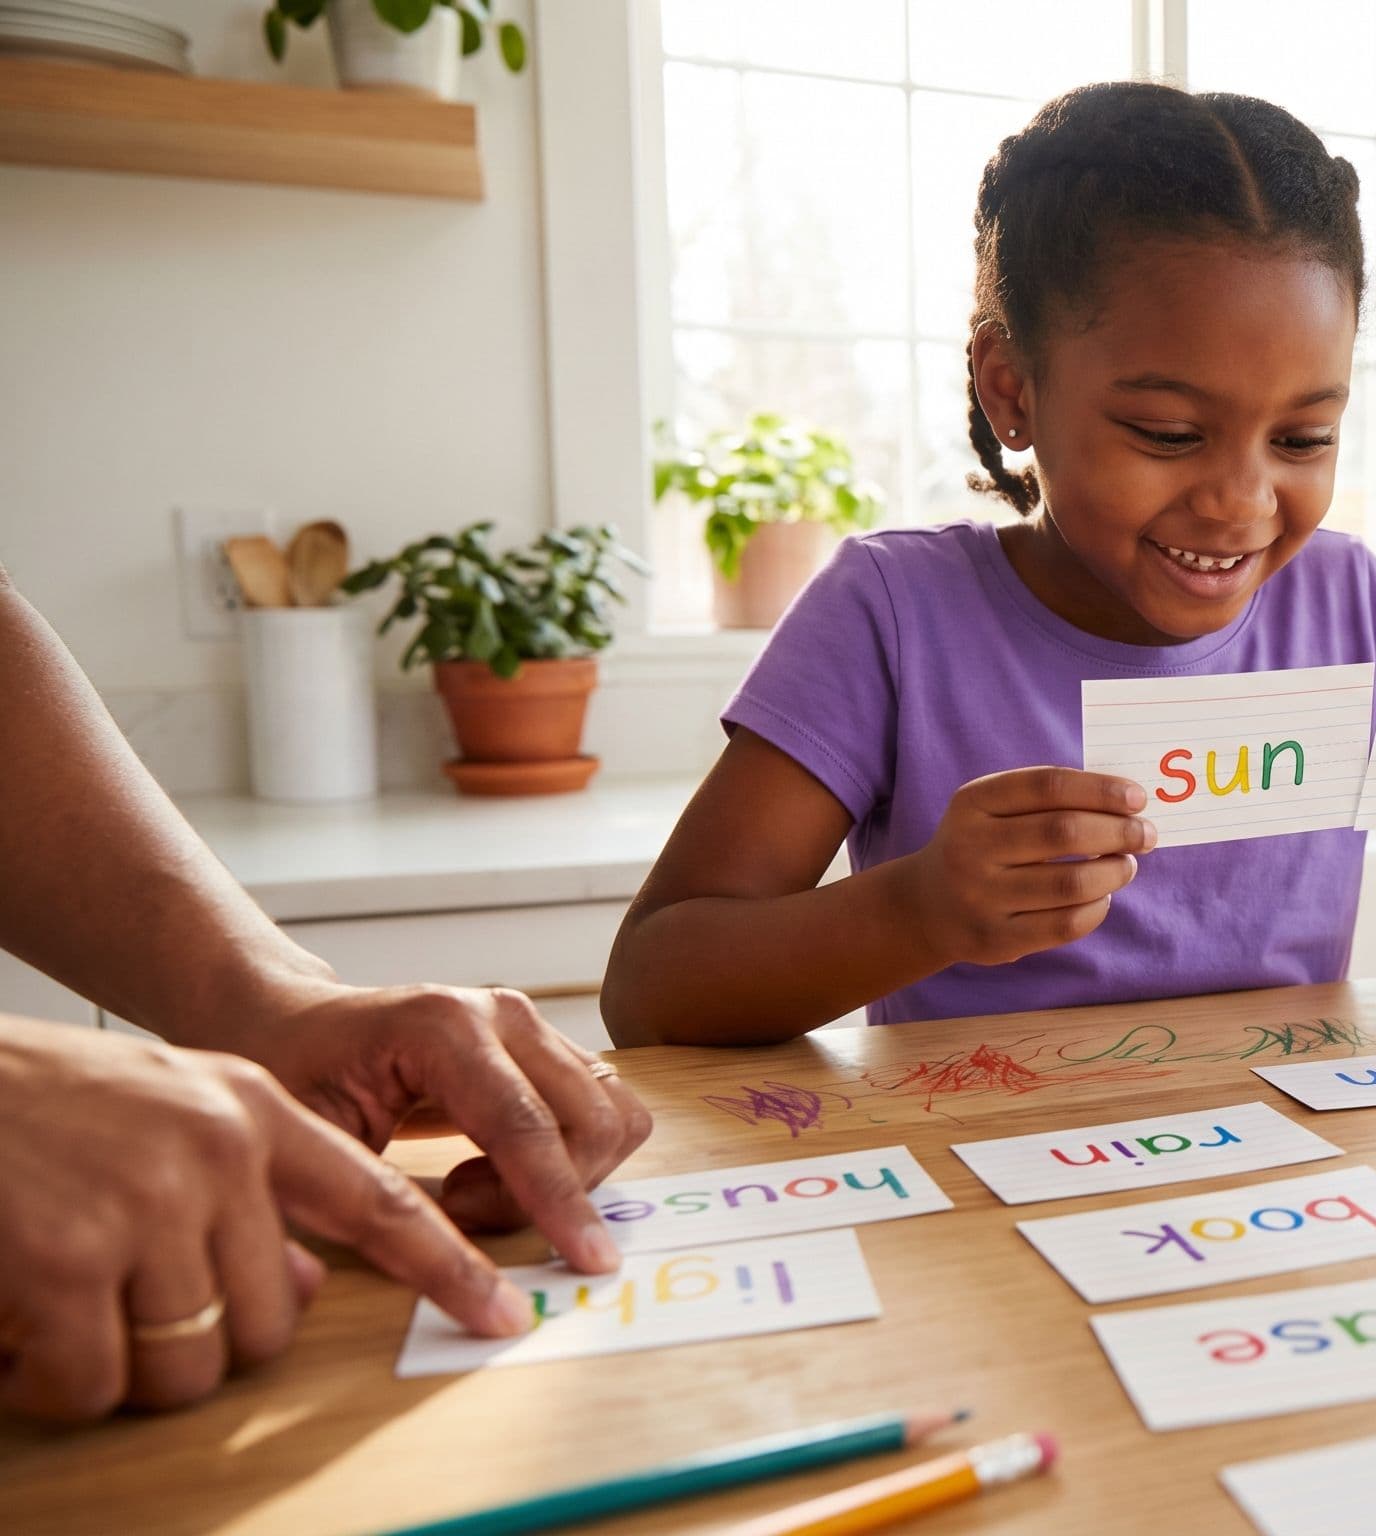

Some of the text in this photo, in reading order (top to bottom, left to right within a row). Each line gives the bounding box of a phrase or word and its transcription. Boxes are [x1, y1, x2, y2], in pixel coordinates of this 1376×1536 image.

[1154, 740, 1305, 804] sun
[1049, 1124, 1243, 1167] rain
[602, 1167, 911, 1222] house
